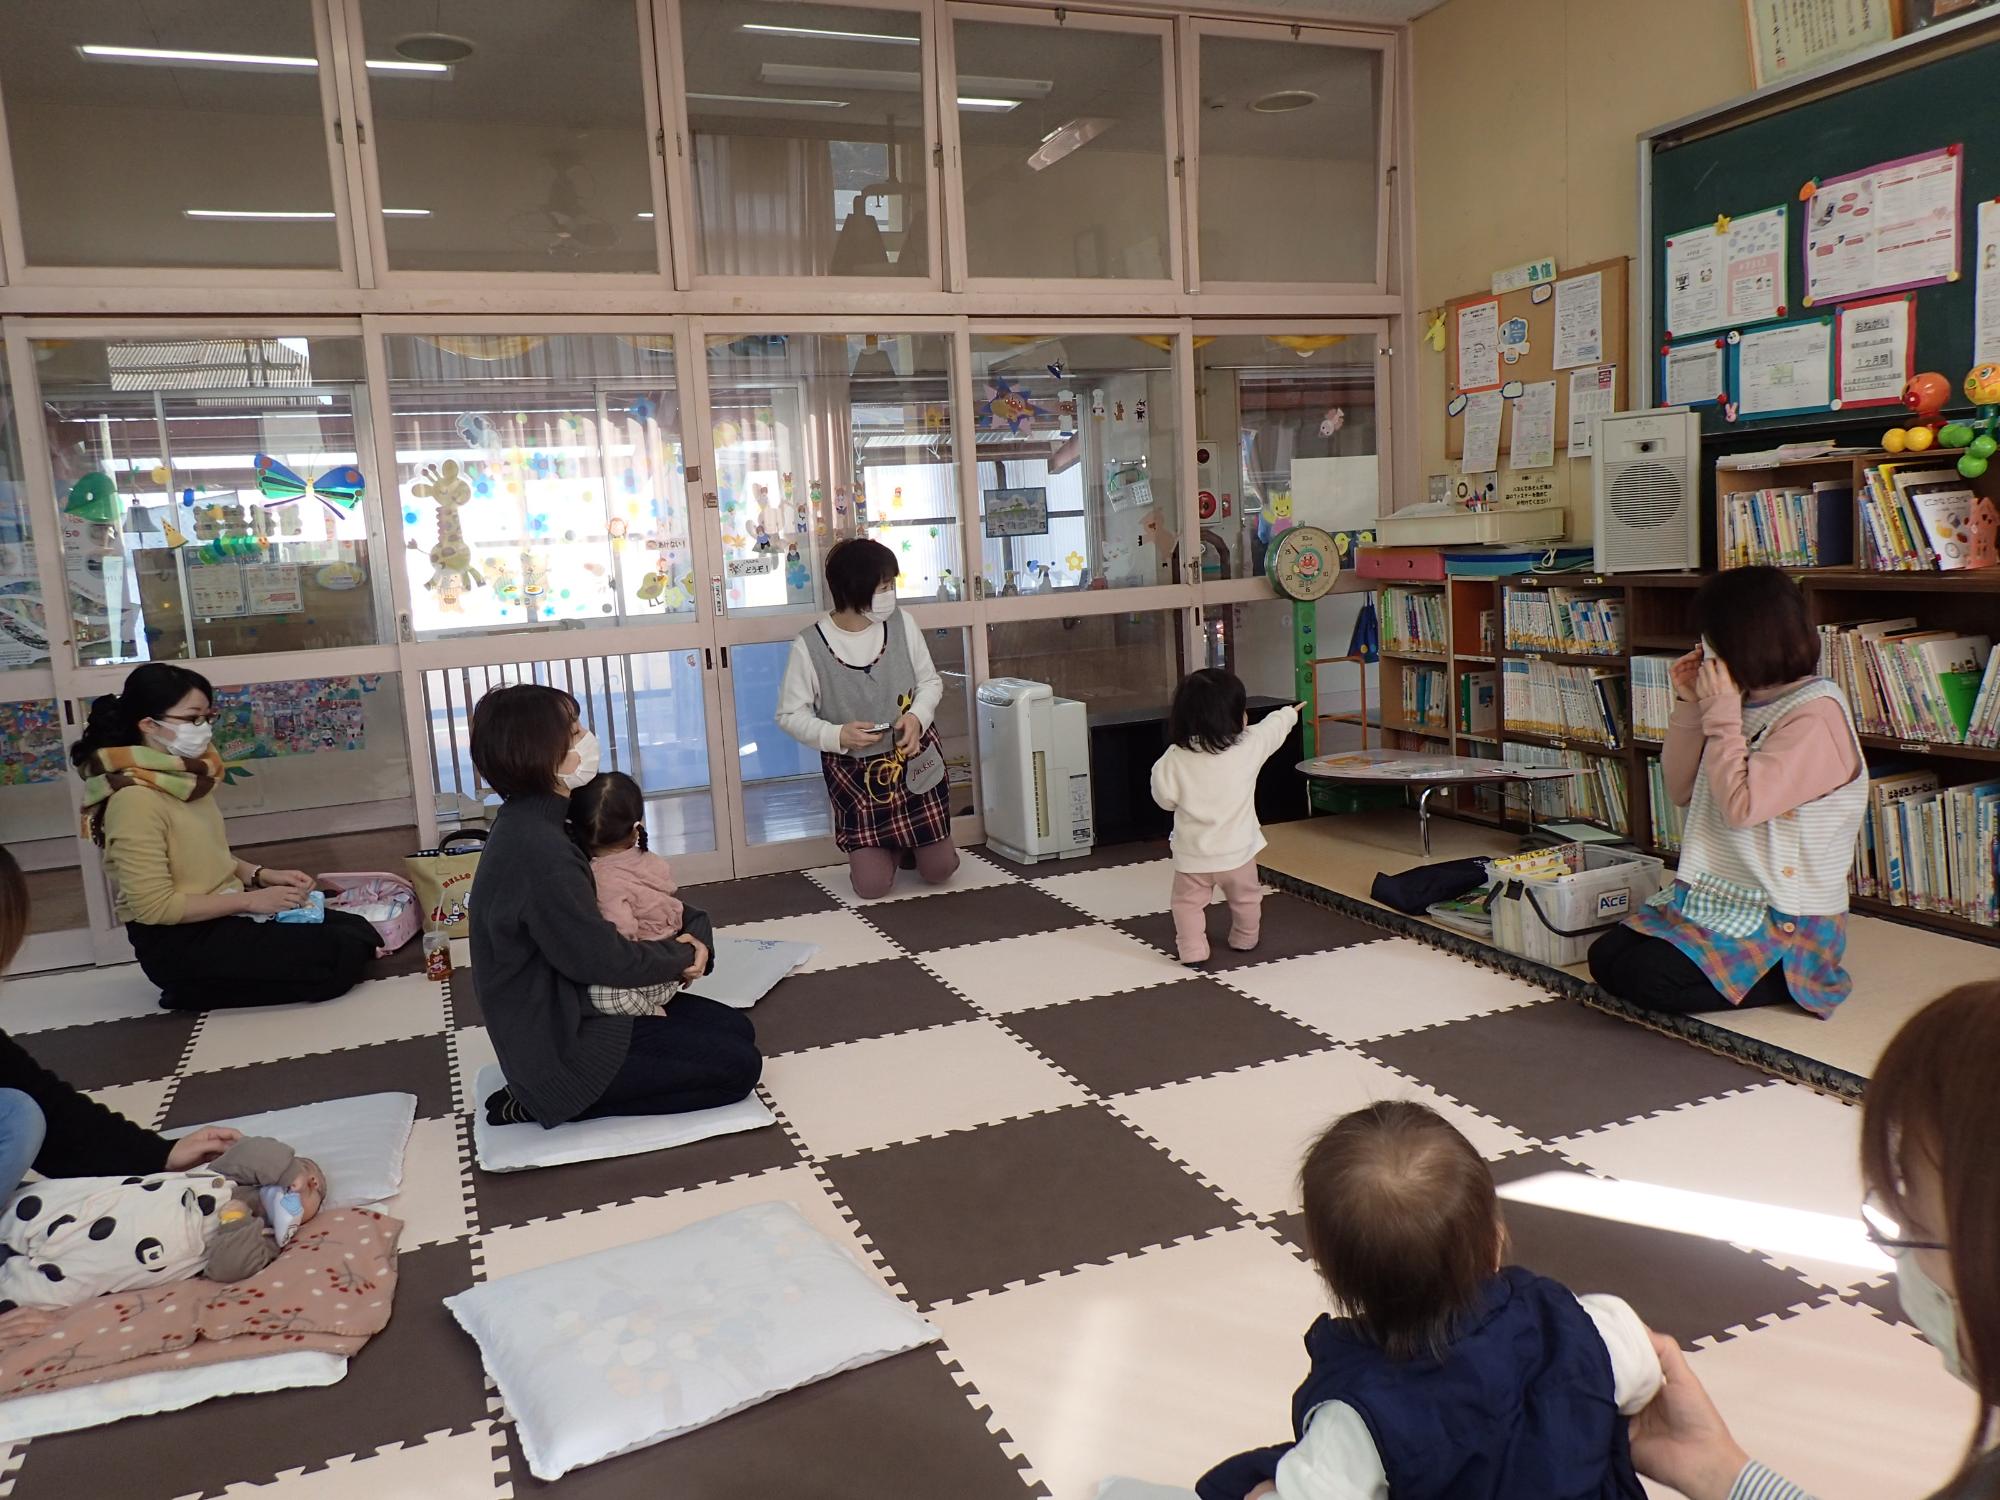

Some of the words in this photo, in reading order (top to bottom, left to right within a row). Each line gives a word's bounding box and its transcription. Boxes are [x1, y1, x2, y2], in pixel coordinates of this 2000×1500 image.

[1856, 318, 1889, 331] おねがい
[1600, 895, 1627, 909] ACE
